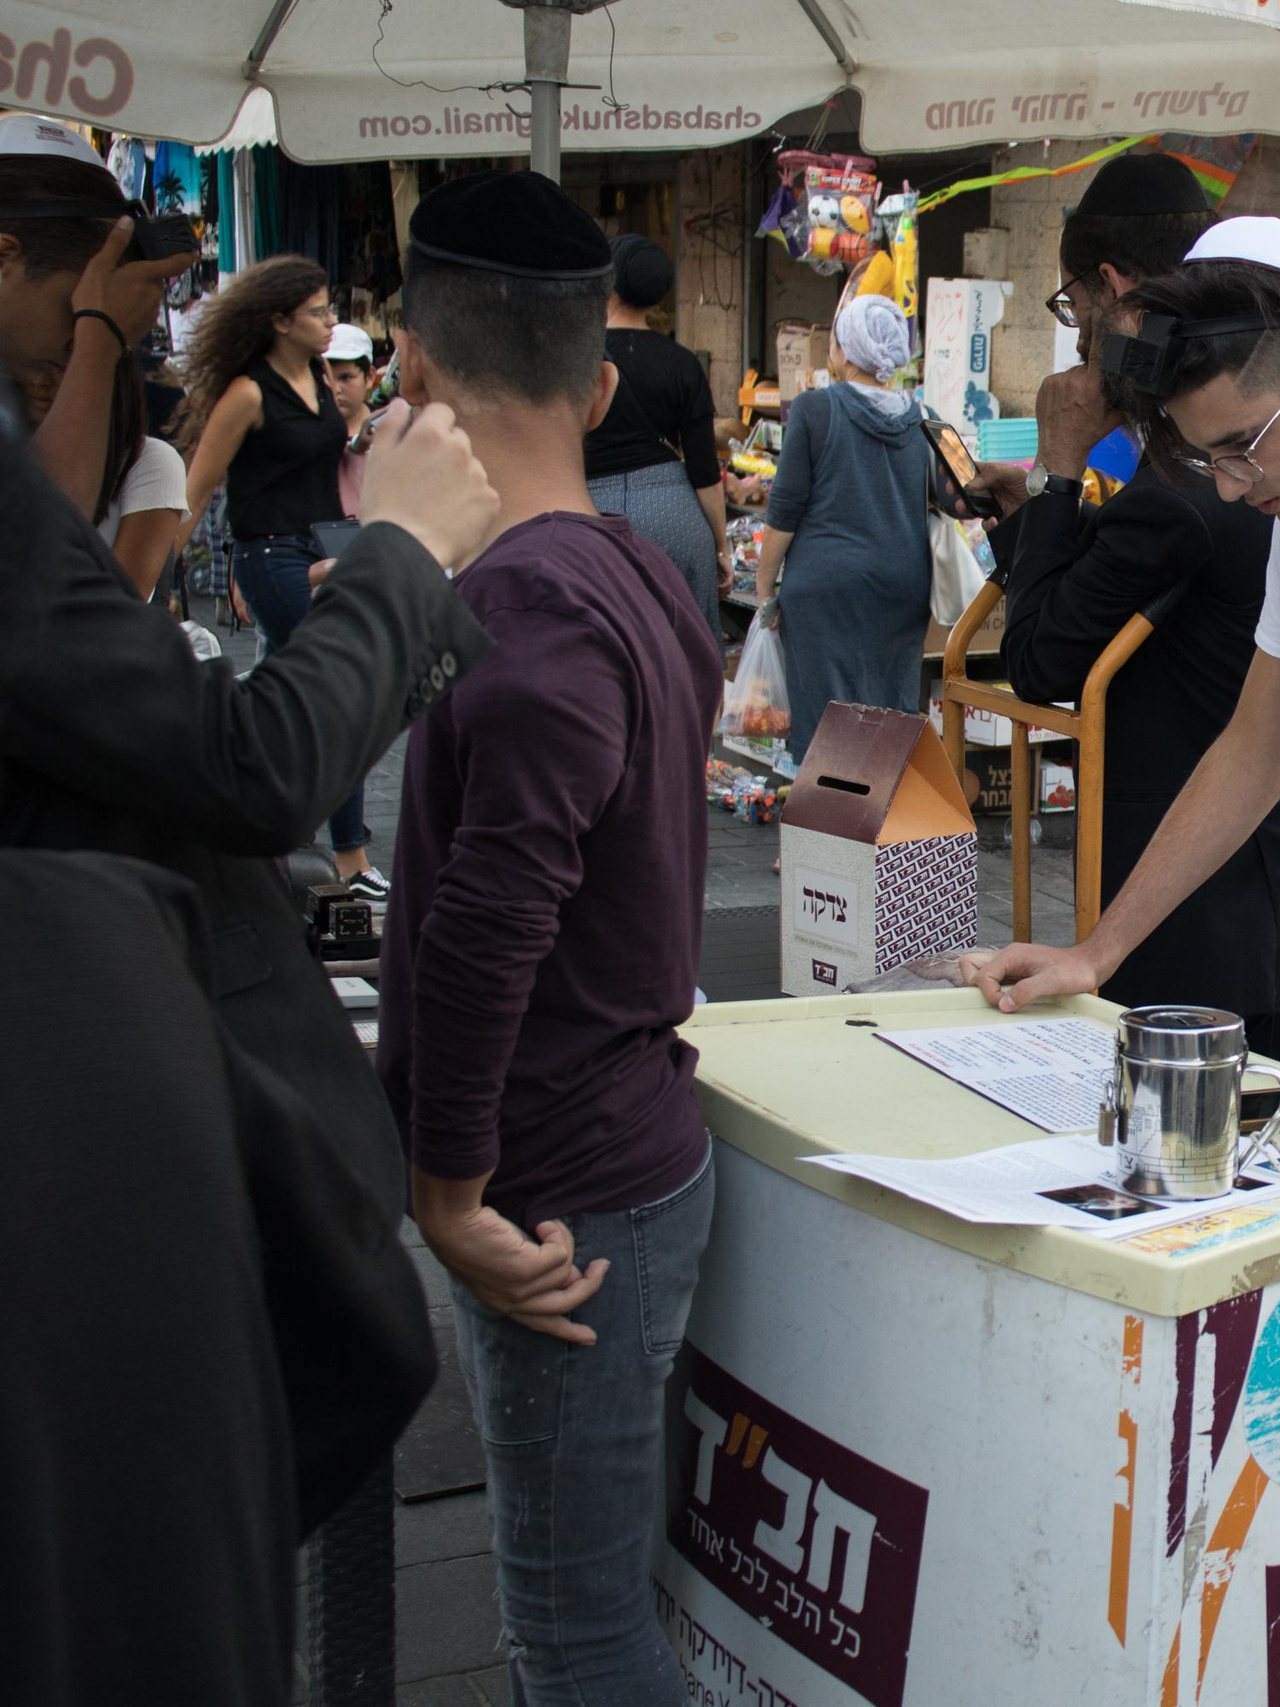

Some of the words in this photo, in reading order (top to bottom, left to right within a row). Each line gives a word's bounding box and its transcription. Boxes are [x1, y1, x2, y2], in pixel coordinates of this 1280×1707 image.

[988, 764, 1012, 787] צל
[803, 886, 847, 923] צדקה
[684, 1384, 877, 1614] חב"ד
[687, 1508, 725, 1563] אחד
[730, 1537, 769, 1593] לכל
[774, 1579, 821, 1634] הלב
[828, 1608, 860, 1658] כל
